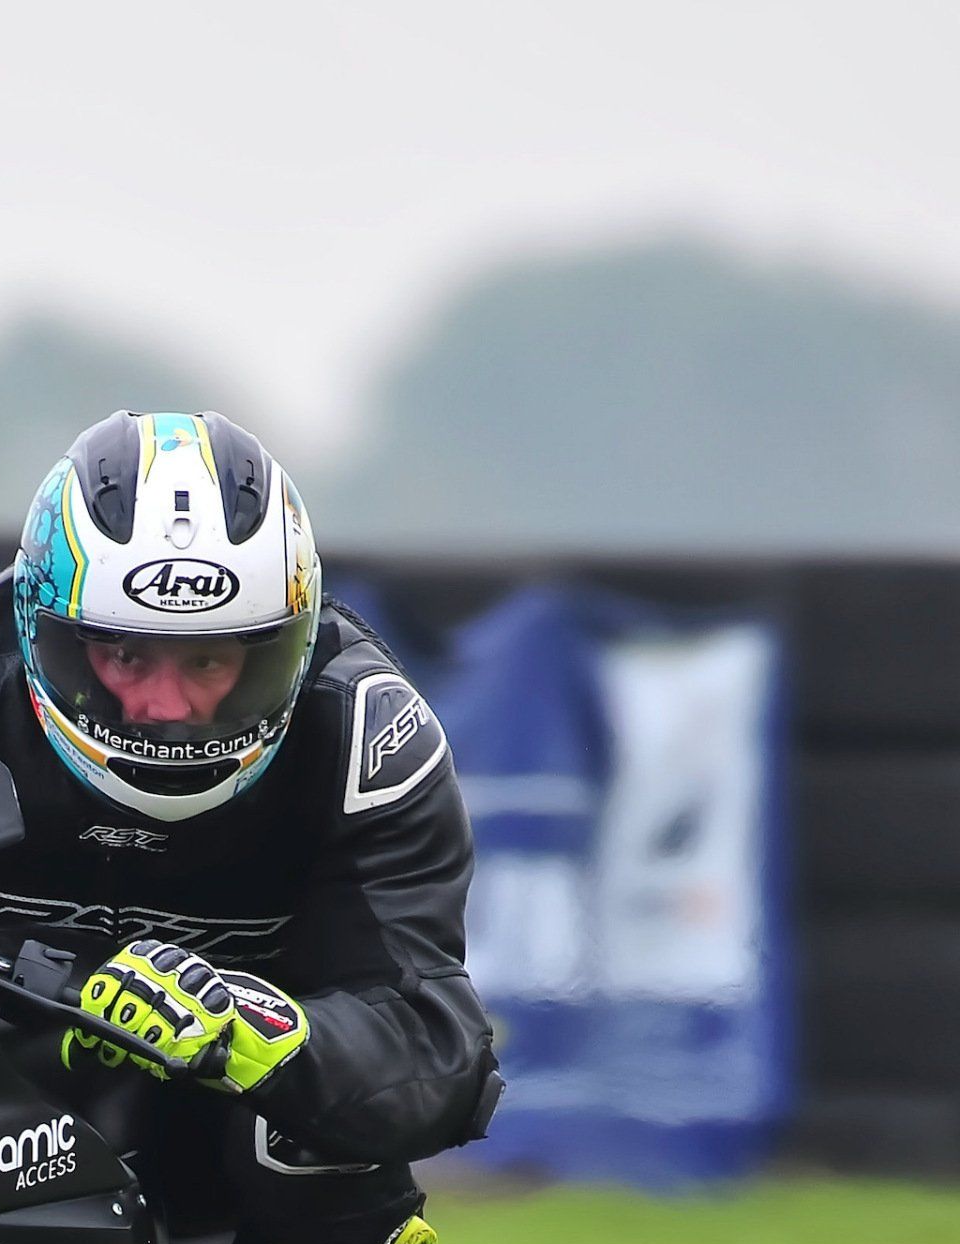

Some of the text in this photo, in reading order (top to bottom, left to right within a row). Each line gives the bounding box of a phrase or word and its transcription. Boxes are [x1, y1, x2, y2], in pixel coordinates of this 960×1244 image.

[128, 563, 228, 597] Arai
[93, 724, 254, 759] Merchant-Guru
[79, 825, 169, 845] RST
[15, 1152, 76, 1191] ACCESS
